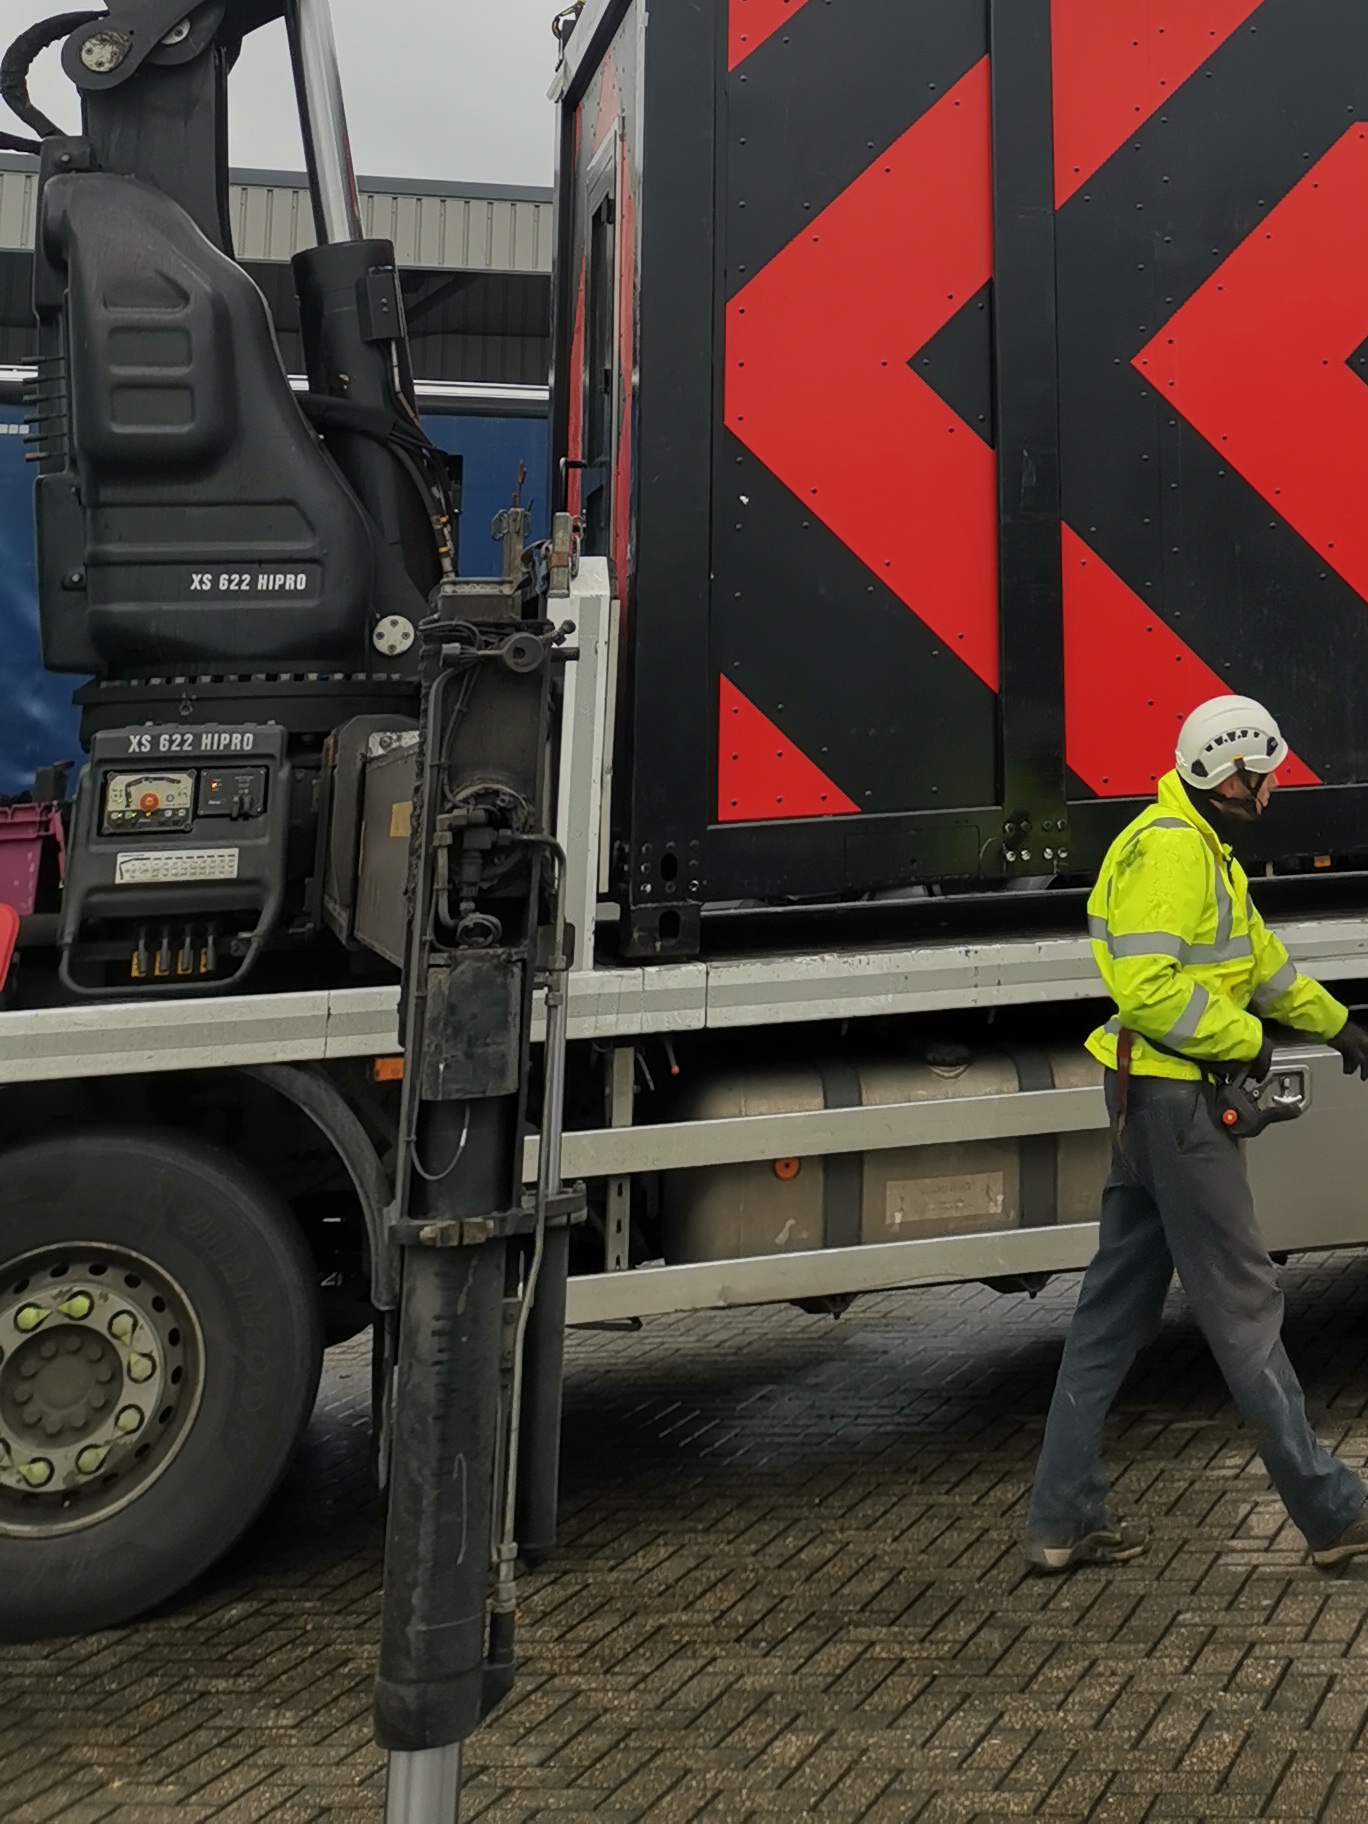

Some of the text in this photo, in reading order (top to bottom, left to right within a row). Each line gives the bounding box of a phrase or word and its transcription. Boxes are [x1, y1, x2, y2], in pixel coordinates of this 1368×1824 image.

[190, 573, 307, 591] XS 622 HIPRO
[127, 732, 254, 753] XS 622 HIPRO
